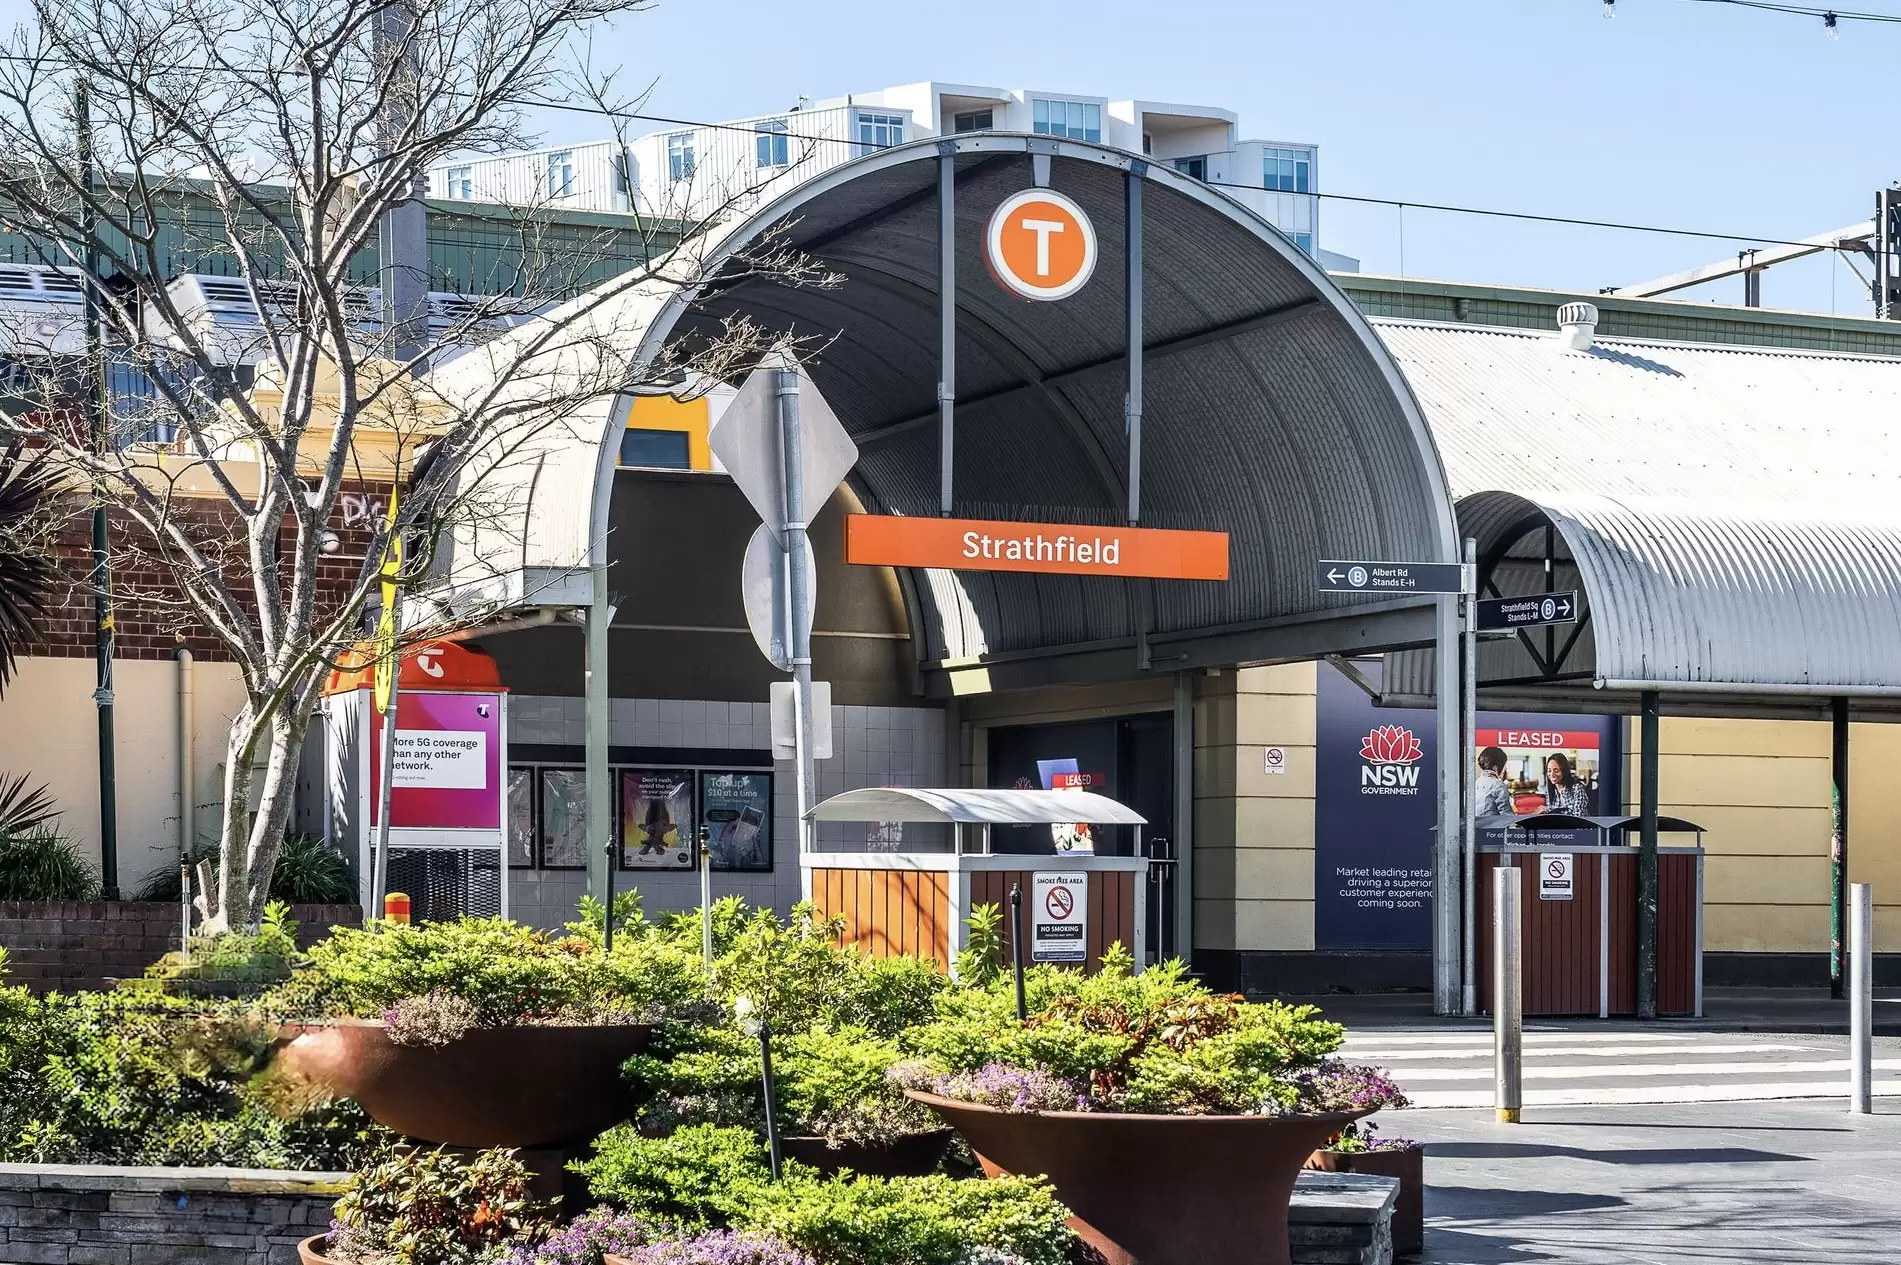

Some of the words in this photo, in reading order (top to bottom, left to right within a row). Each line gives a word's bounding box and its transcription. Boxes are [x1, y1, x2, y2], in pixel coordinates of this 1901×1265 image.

[1021, 218, 1065, 277] T
[962, 531, 1119, 565] Strathfield
[1372, 568, 1397, 577] Albert
[1397, 568, 1408, 577] Rd
[1372, 578, 1399, 587] Stands
[1400, 578, 1416, 587] E-H
[1501, 602, 1530, 613] Strathfield
[1531, 601, 1539, 611] Sq
[1507, 613, 1527, 622] Stands
[1527, 612, 1539, 620] L-M
[417, 738, 430, 747] 5G
[433, 739, 478, 750] coverage
[1498, 731, 1564, 747] LEASED
[393, 749, 411, 758] han
[414, 751, 432, 760] any
[434, 750, 461, 759] other
[1065, 774, 1092, 787] LEASED
[1361, 765, 1420, 787] NSW
[709, 776, 728, 790] Top
[707, 787, 722, 797] $10
[723, 789, 732, 797] at
[740, 789, 758, 797] time
[1361, 787, 1419, 796] GOVERNMENT
[1336, 867, 1370, 877] Market
[1372, 867, 1408, 879] leading
[1411, 867, 1432, 877] retai
[1347, 878, 1381, 888] driving
[1393, 879, 1432, 888] superior
[1339, 889, 1385, 897] customer
[1388, 889, 1433, 899] experienc
[1357, 899, 1394, 909] coming
[1397, 900, 1423, 908] soon.
